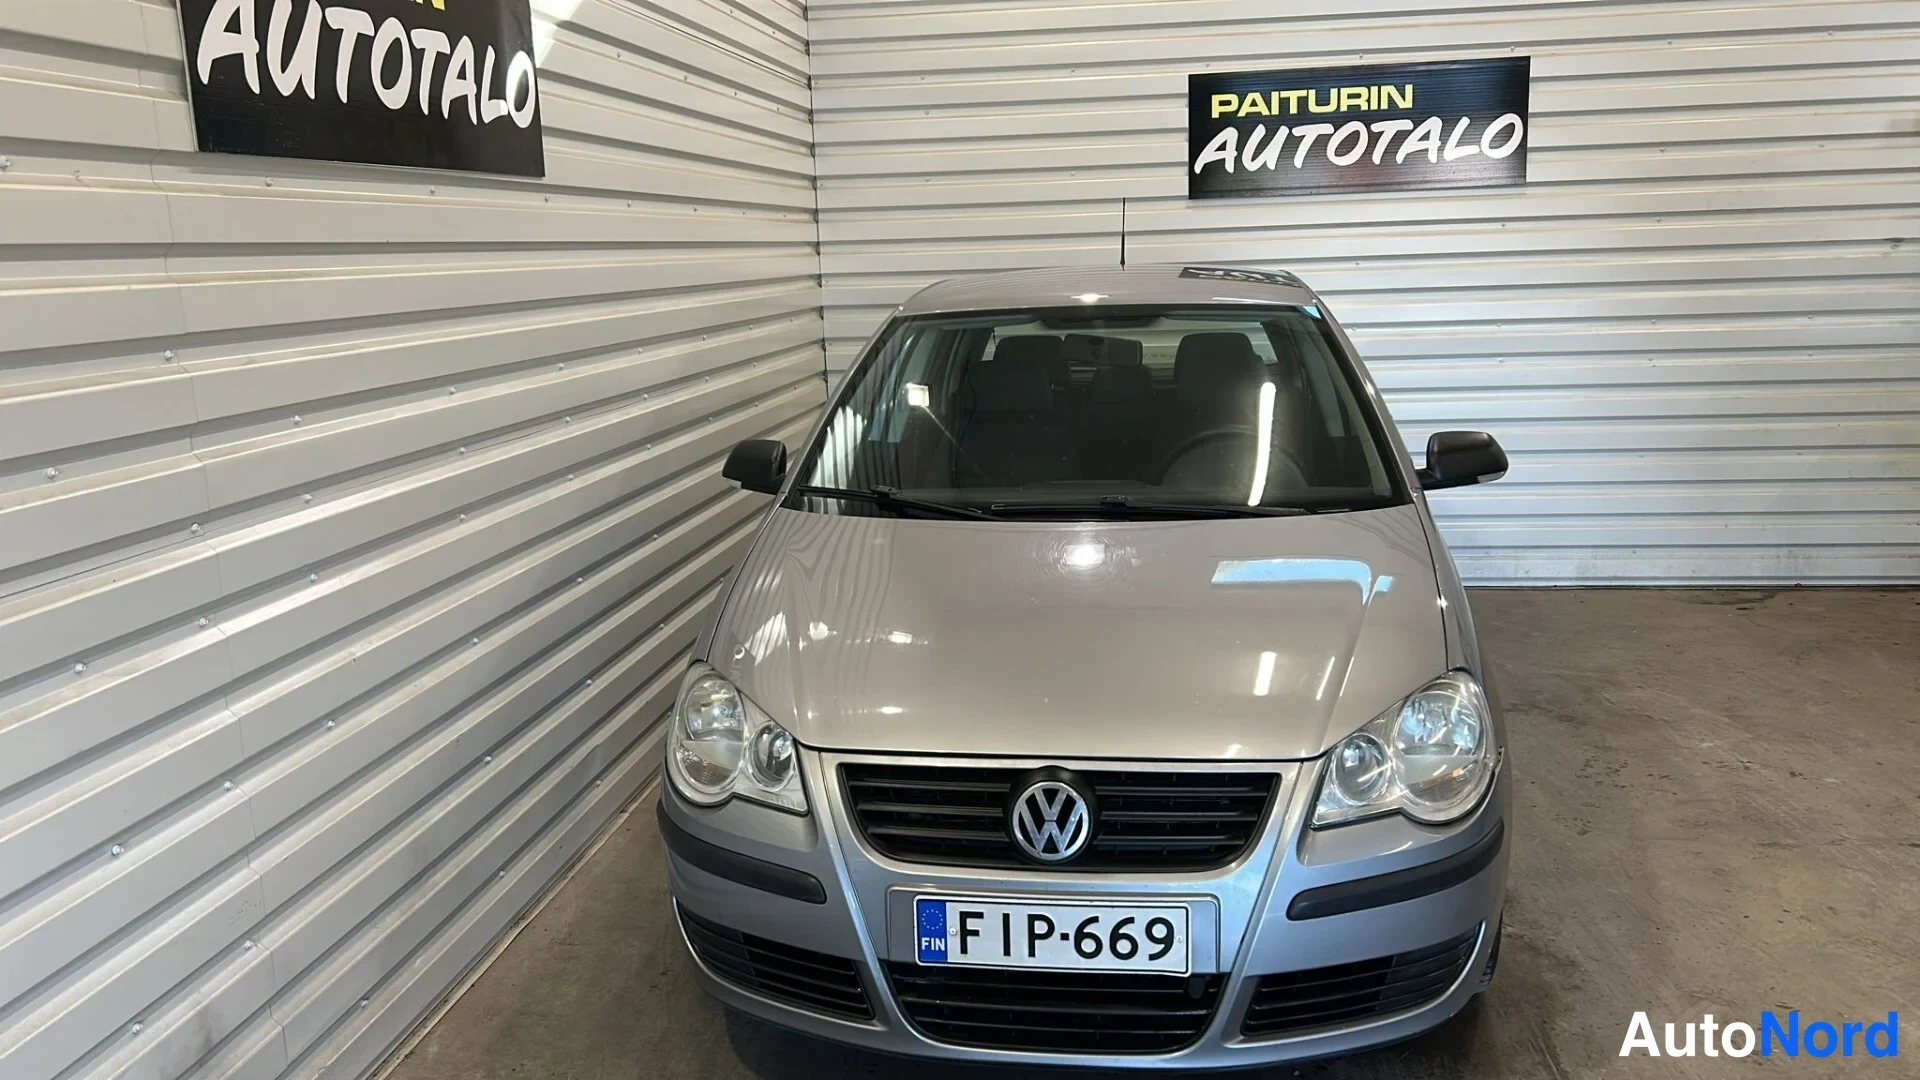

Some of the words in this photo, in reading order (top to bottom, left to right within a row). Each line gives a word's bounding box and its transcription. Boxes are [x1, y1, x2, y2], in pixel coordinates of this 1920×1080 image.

[197, 0, 536, 129] AUTOTALO
[1211, 84, 1414, 119] PAITURIN
[1193, 112, 1525, 174] AUTOTALO
[921, 937, 945, 951] FIN
[958, 910, 1175, 961] FIP-669
